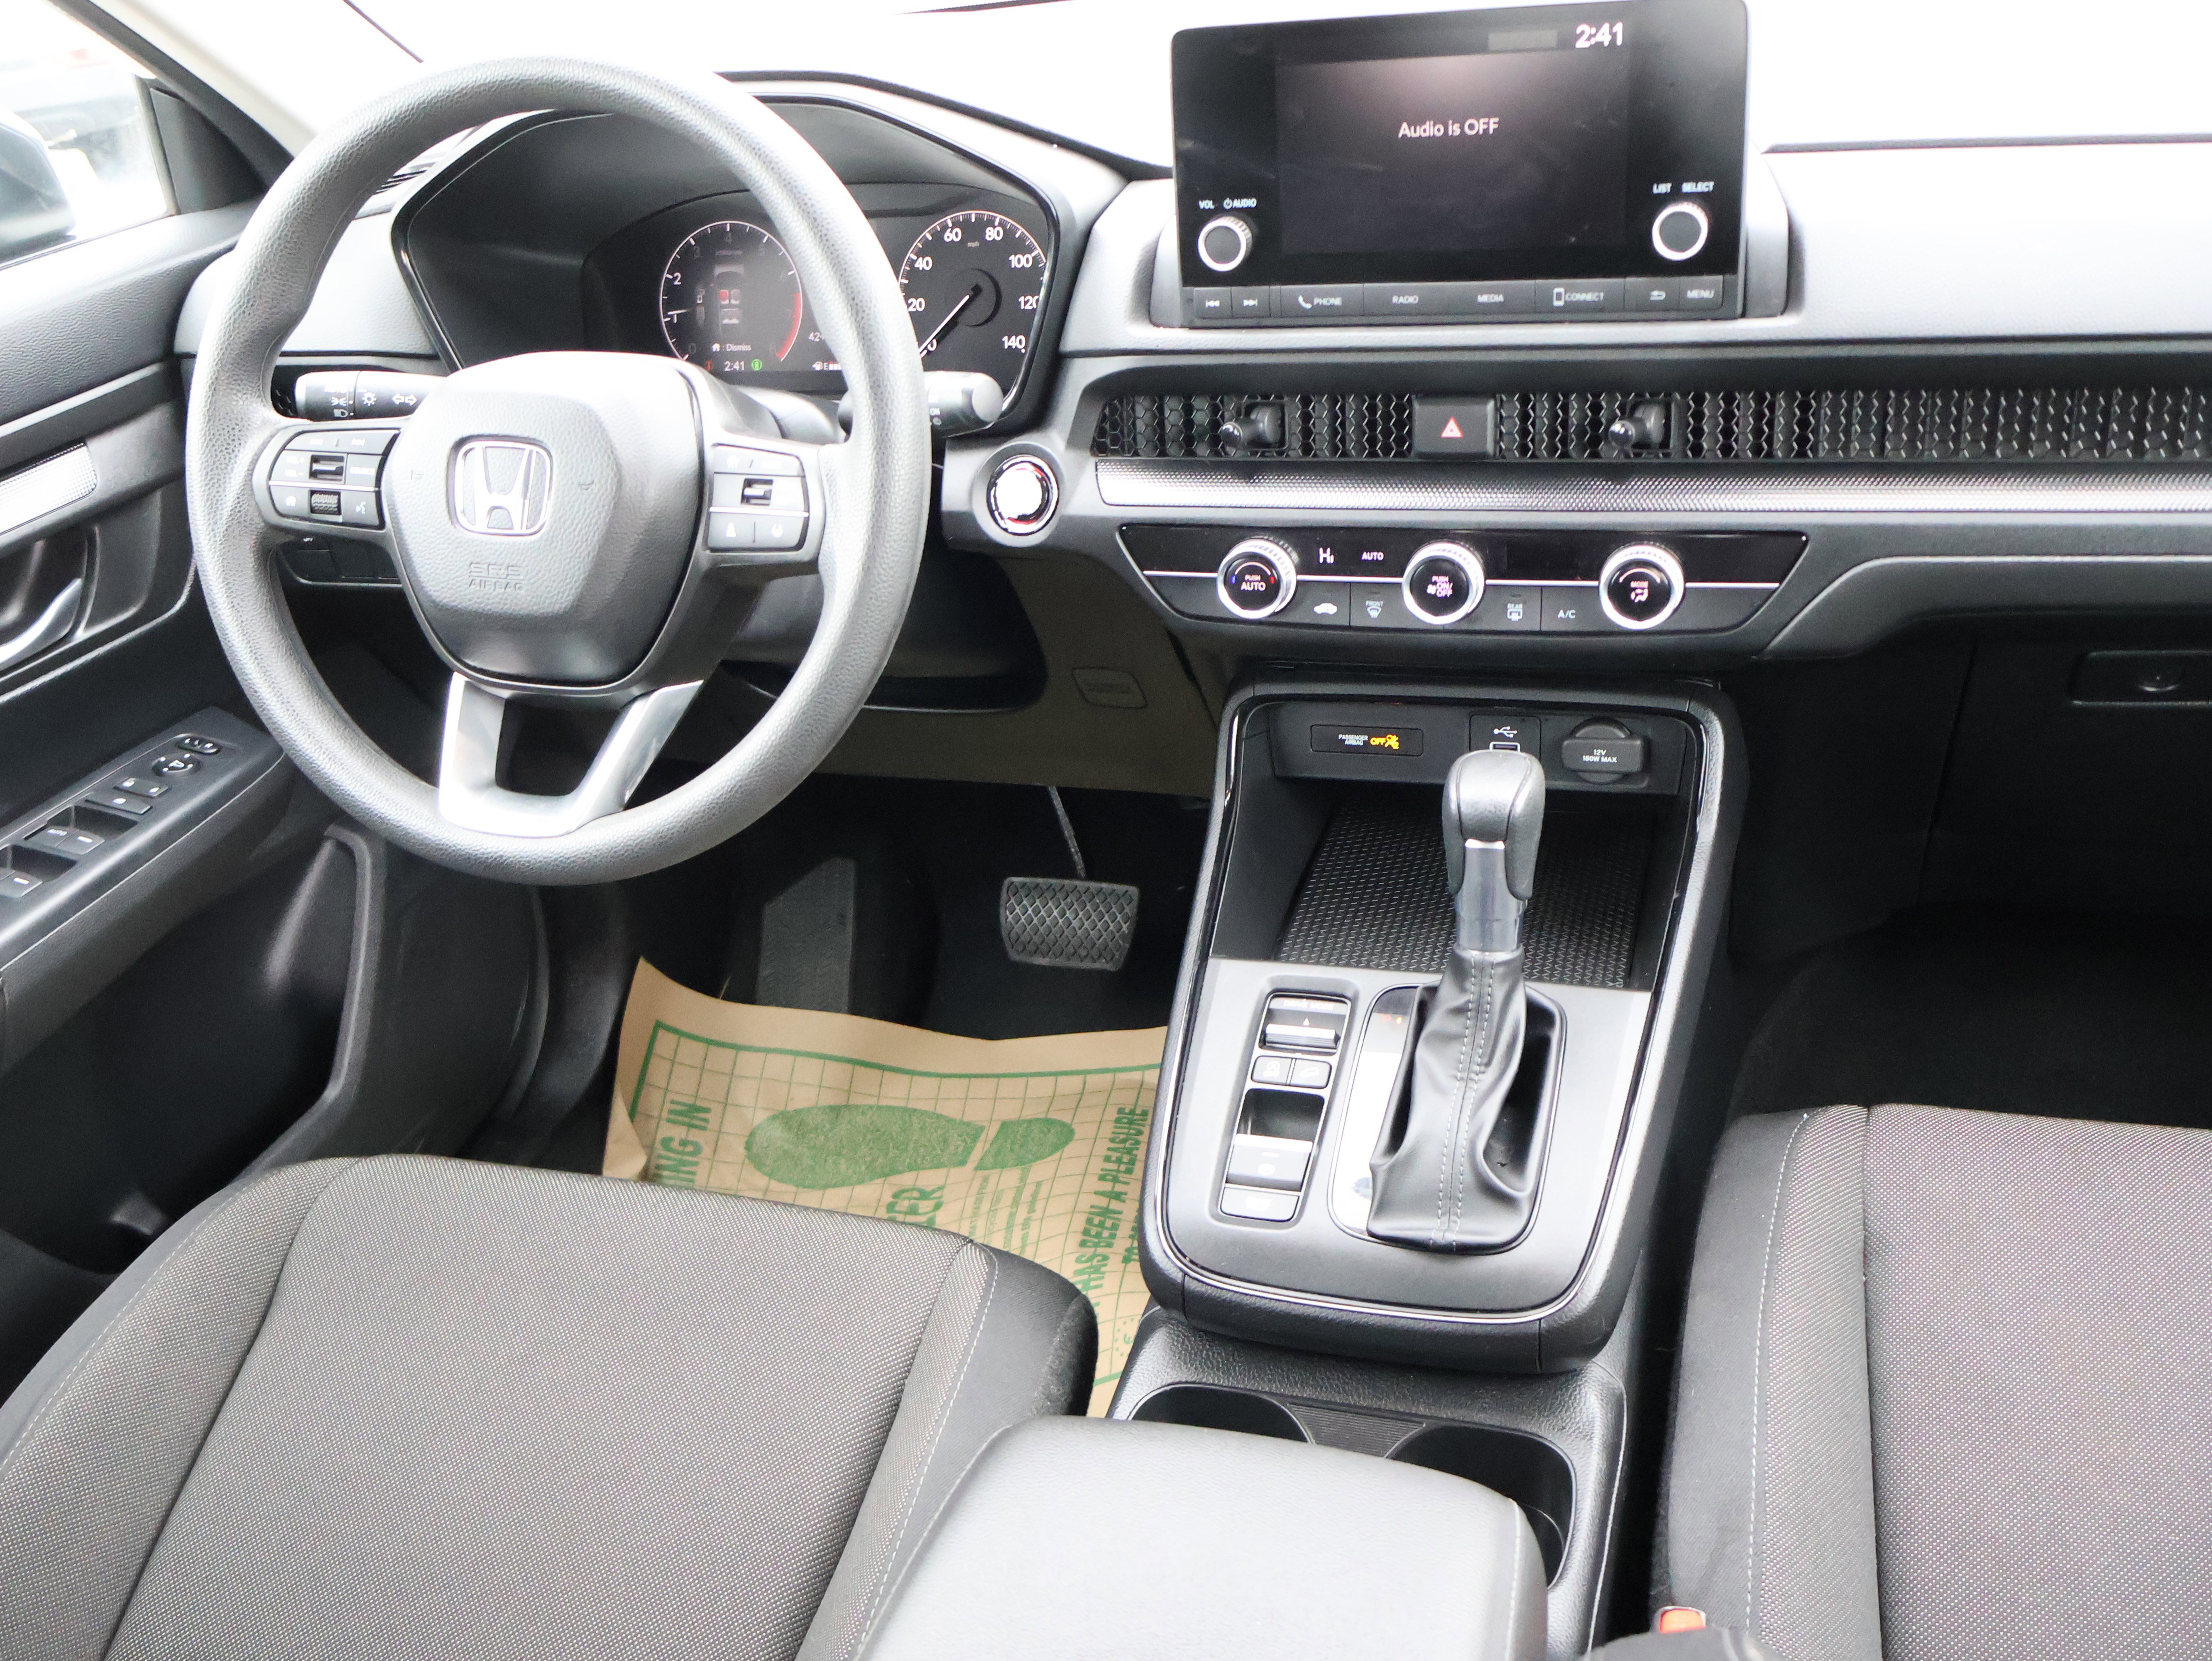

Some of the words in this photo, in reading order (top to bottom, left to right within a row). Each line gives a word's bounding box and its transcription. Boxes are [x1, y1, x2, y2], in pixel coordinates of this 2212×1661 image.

[1575, 22, 1624, 49] 2:41
[1398, 121, 1444, 138] Audio
[1448, 120, 1461, 137] is
[1464, 118, 1499, 136] OFF
[1652, 182, 1673, 194] LIST
[1681, 181, 1715, 194] SELECT
[1198, 199, 1215, 209] VOL
[1232, 197, 1257, 208] AUDIO
[943, 228, 962, 242] 60
[985, 226, 1003, 241] 80
[914, 256, 933, 270] 40
[1008, 254, 1033, 268] 100
[673, 272, 682, 285] 2
[1392, 295, 1419, 304] RADIO
[1477, 293, 1504, 303] MEDIA
[1565, 291, 1605, 302] CONNECT
[1686, 289, 1715, 299] MENU
[908, 297, 925, 312] 20
[1314, 296, 1342, 306] PHONE
[726, 343, 751, 352] Dismiss
[1002, 335, 1026, 349] 140
[724, 361, 745, 371] 2:41
[1362, 551, 1384, 561] AUTO
[1241, 581, 1266, 591] AUTO
[1436, 589, 1453, 598] OFF
[1557, 609, 1576, 618] A/C
[1370, 737, 1386, 745] OFF
[665, 1099, 712, 1131] IN
[1098, 1107, 1149, 1186] PLEASURE
[653, 1136, 704, 1188] ING
[1094, 1189, 1128, 1203] A
[1079, 1204, 1123, 1249] BEEN
[1075, 1253, 1110, 1293] HAS
